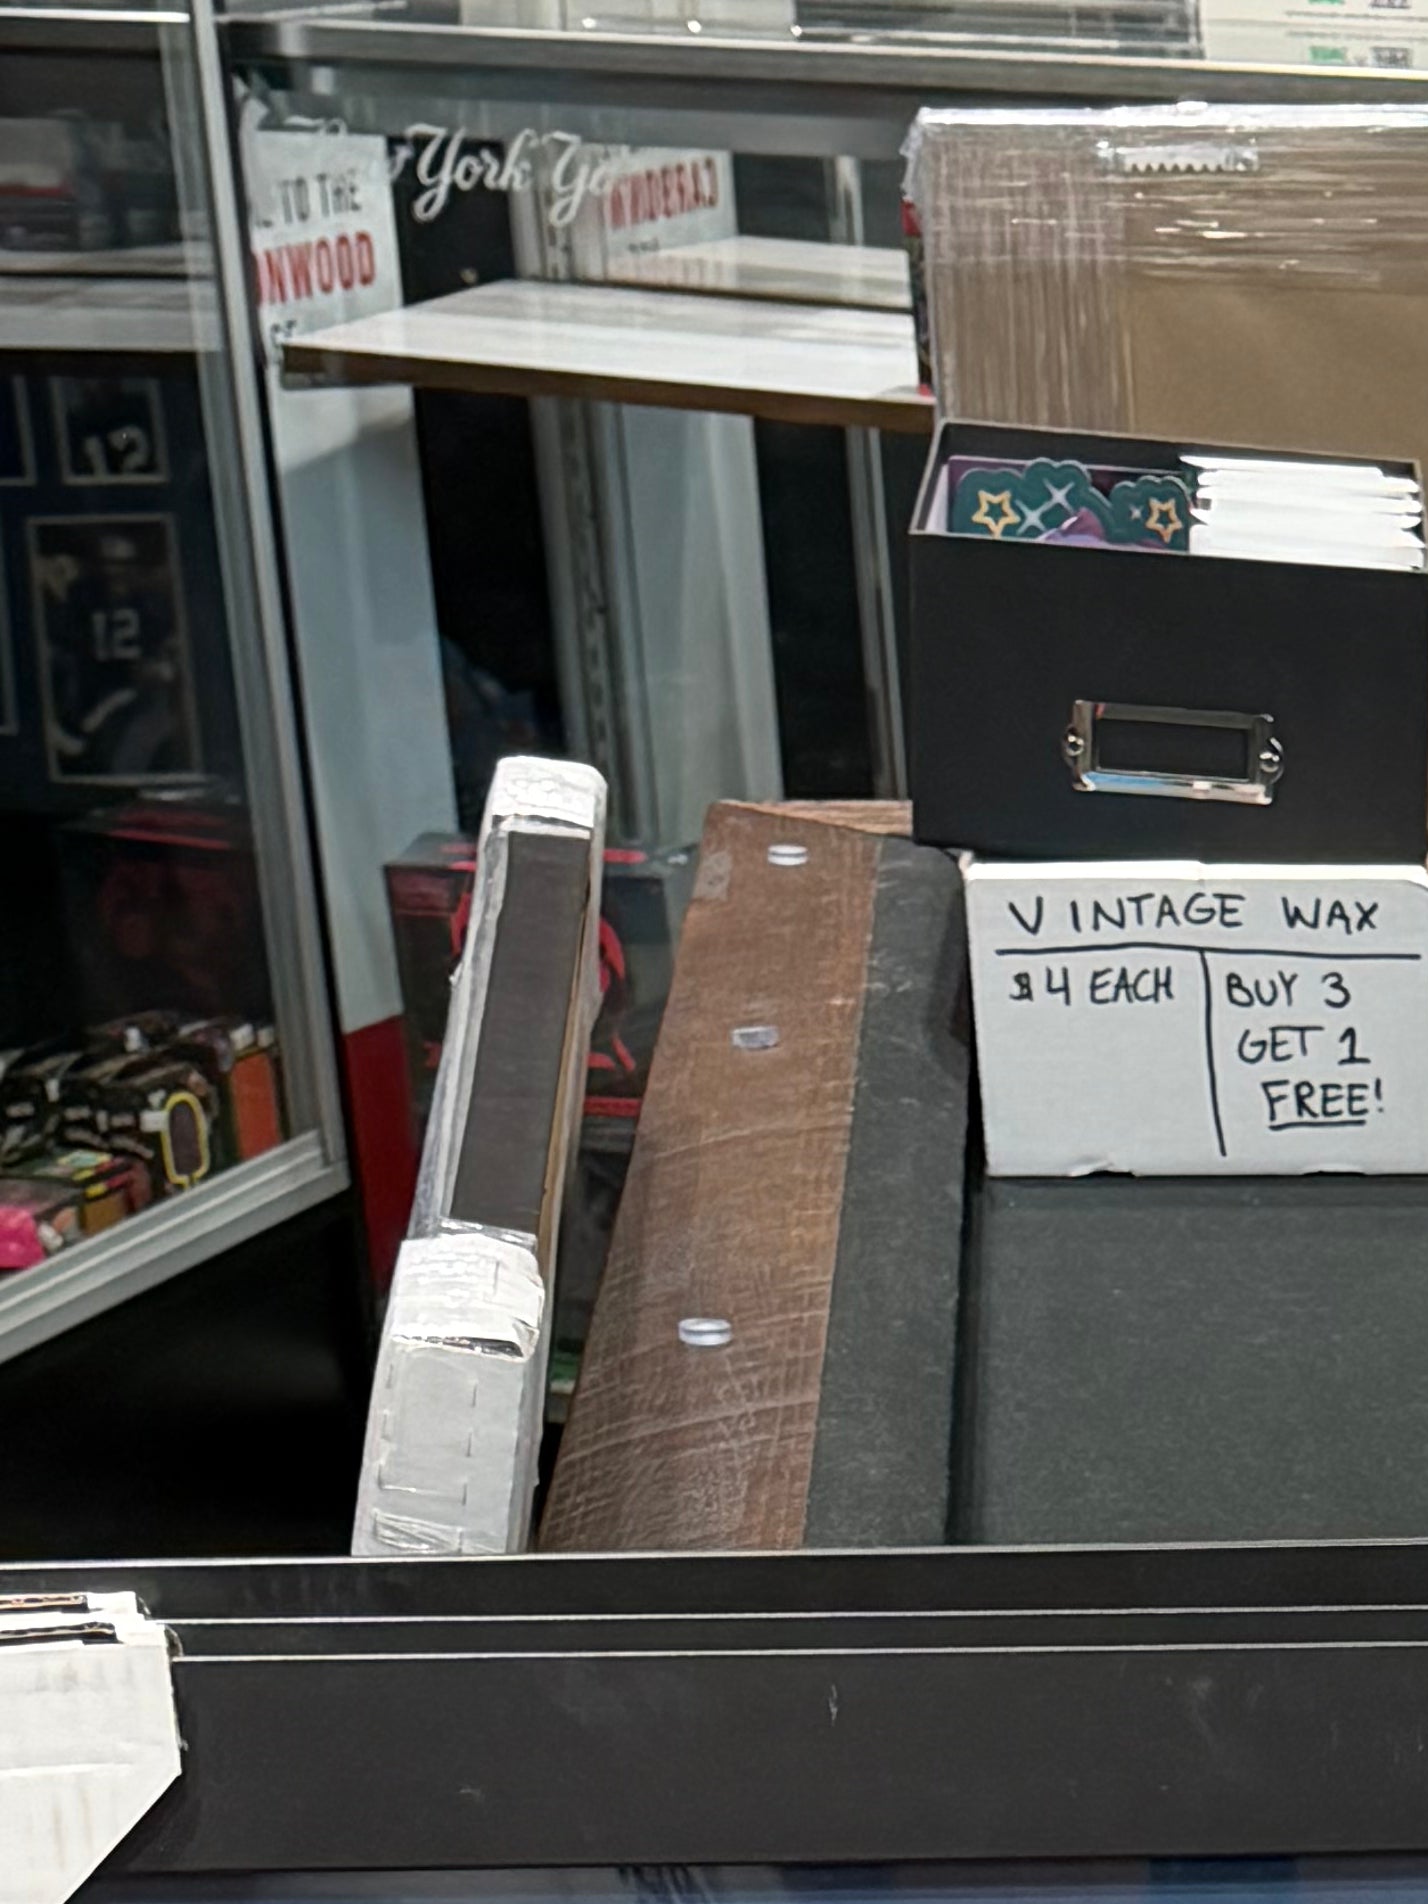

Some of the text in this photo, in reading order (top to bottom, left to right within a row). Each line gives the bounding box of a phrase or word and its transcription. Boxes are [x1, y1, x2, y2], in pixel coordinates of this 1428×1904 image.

[404, 122, 540, 223] York
[278, 176, 310, 225] TO
[252, 231, 375, 304] NWOOD
[1009, 892, 1380, 936] VINTAGE WAX
[1089, 966, 1175, 1005] EACH
[1226, 971, 1352, 1008] BUY 3
[1237, 1025, 1372, 1065] GET 1
[1261, 1077, 1385, 1122] FREE!
